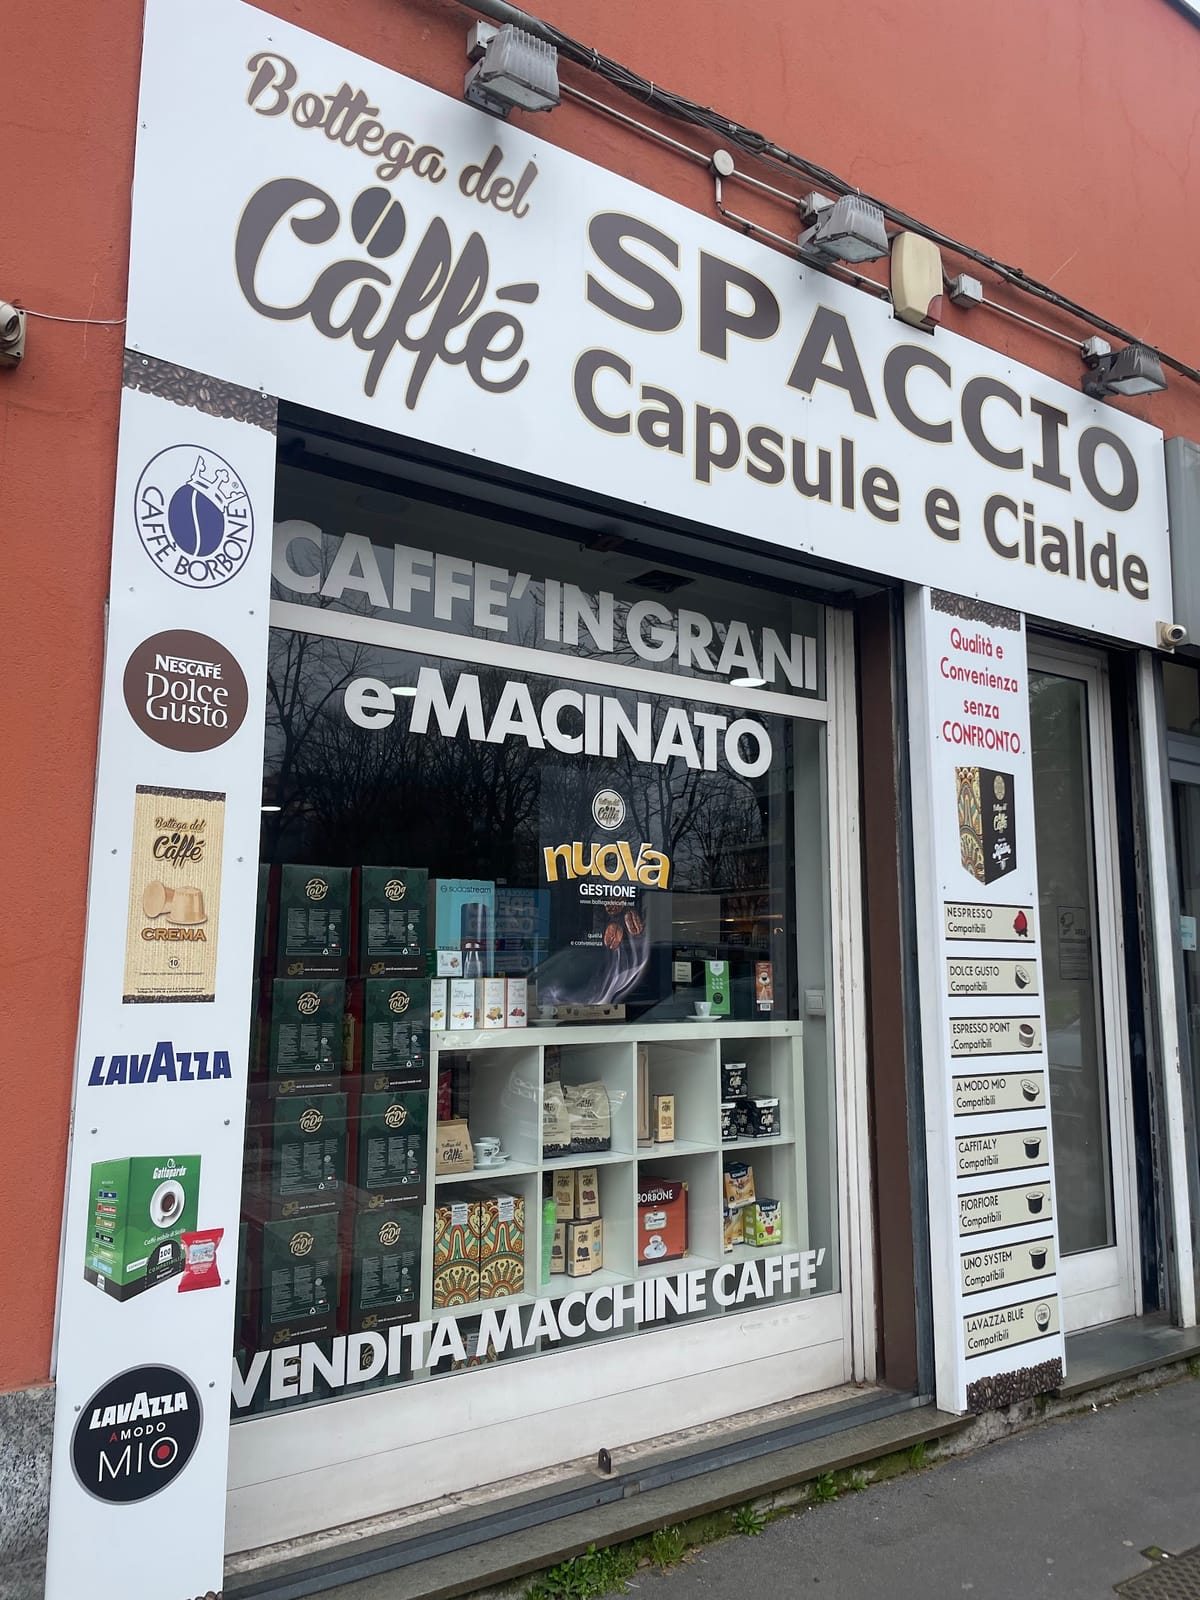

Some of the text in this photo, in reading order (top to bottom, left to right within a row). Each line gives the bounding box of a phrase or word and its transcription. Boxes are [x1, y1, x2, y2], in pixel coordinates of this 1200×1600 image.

[247, 51, 540, 219] Bottega del
[234, 177, 540, 411] Caffé
[585, 210, 1140, 513] SPACCIO
[572, 347, 1150, 601] Capsule e Cialde
[174, 507, 249, 582] BORBONE
[543, 578, 614, 653] IN
[626, 600, 818, 692] GRANI
[950, 628, 1003, 659] Qualità e
[940, 657, 1018, 693] Convenienza
[145, 672, 229, 707] Dolce
[146, 697, 228, 728] Gusto
[963, 698, 999, 719] senza
[344, 666, 773, 778] e MACINATO
[942, 721, 1021, 754] CONFRONTO
[579, 884, 636, 898] GESTIONE
[947, 908, 993, 919] NESPRESSO
[141, 928, 207, 941] CREMA
[948, 922, 986, 936] Compatibili
[169, 959, 179, 967] 10
[950, 965, 999, 977] DOLCE GUSTO
[951, 981, 987, 994] Compatibili
[953, 1022, 1010, 1034] ESPRESSO POINT
[953, 1037, 992, 1051] Compatibili
[88, 1041, 232, 1086] LAVAZZA
[956, 1078, 1006, 1092] A MODO MIO
[956, 1095, 996, 1110] Compatibili
[958, 1138, 997, 1154] CAFFITALY
[959, 1154, 999, 1170] Compatibili
[960, 1195, 999, 1212] FIORFIORE
[961, 1213, 1002, 1228] Compatibili
[963, 1251, 1012, 1270] UNO SYSTEM
[964, 1271, 1005, 1287] Compatibili
[967, 1308, 1024, 1333] LAVAZZA BLUE
[230, 1315, 468, 1408] VENDITA
[475, 1271, 706, 1358] MACCHINE
[967, 1328, 1009, 1350] Compatibili
[89, 1391, 188, 1430] LAVAZZA
[109, 1421, 166, 1443] A MODO
[98, 1436, 178, 1482] MIO
